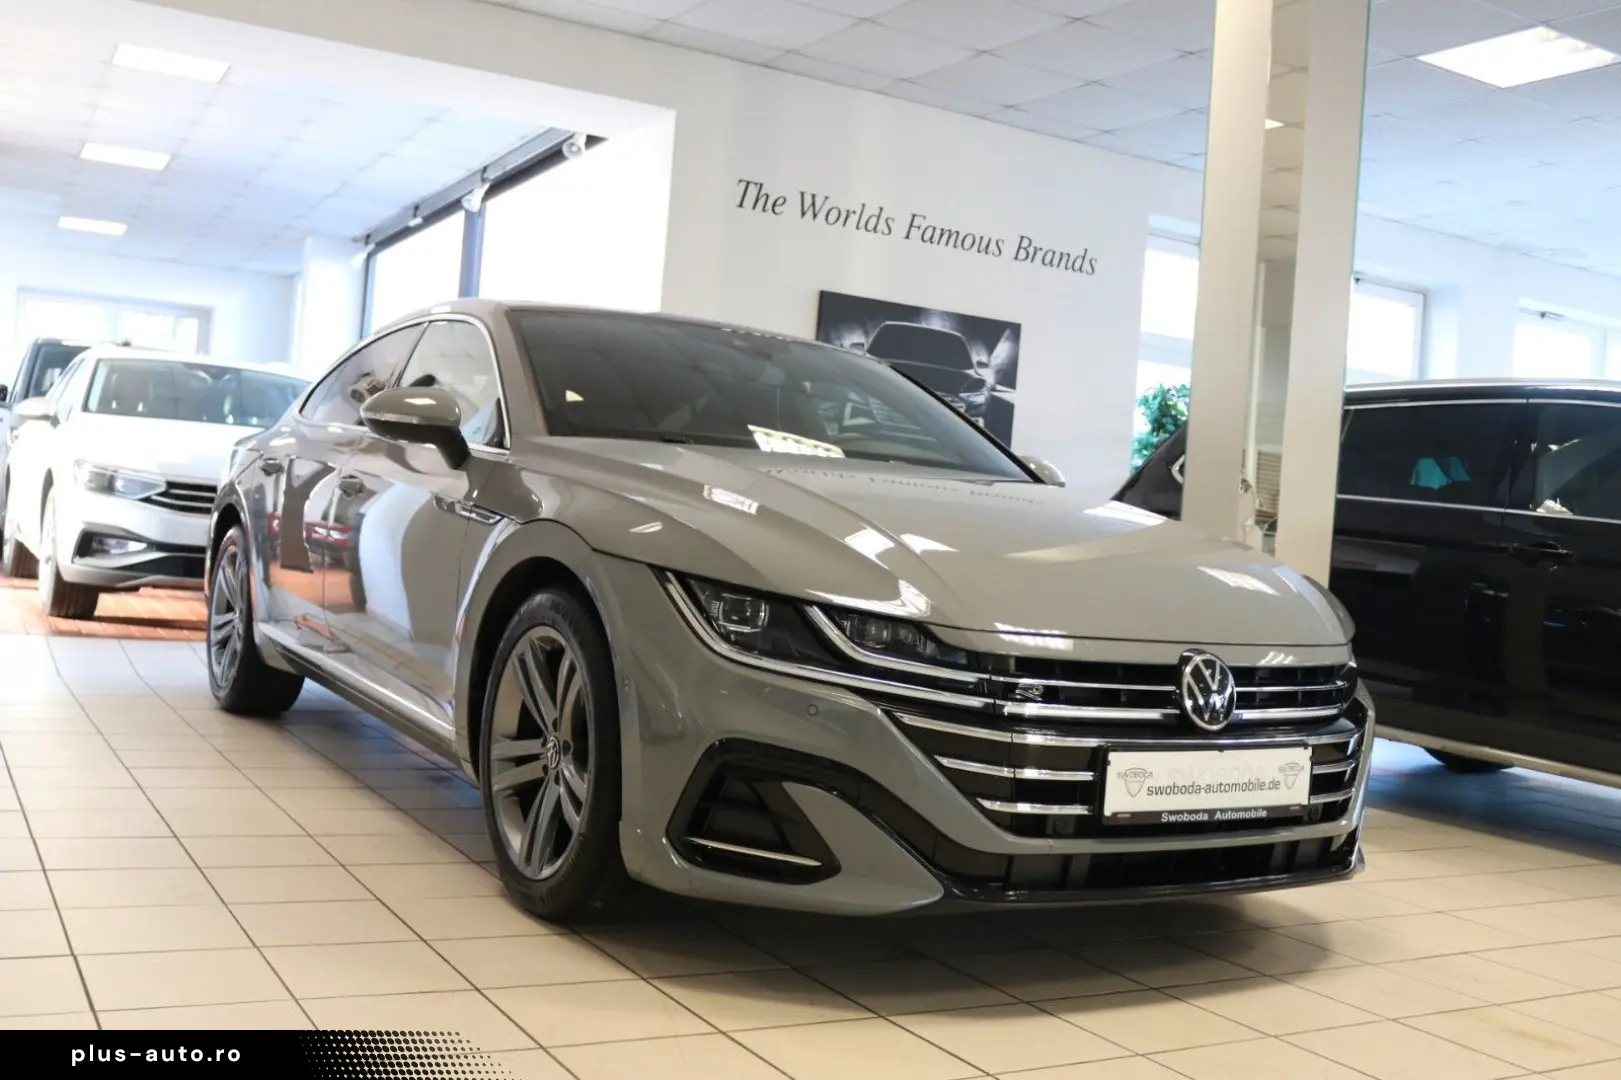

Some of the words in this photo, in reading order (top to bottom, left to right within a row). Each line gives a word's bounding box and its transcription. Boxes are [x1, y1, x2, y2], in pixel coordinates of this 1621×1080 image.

[735, 178, 788, 217] The
[799, 190, 895, 238] Worlds
[903, 212, 1005, 258] Famous
[1012, 234, 1097, 276] Brands
[1146, 778, 1281, 797] swoboda-automobile.de
[1161, 811, 1208, 823] Swoboda
[1214, 808, 1268, 821] Automobile
